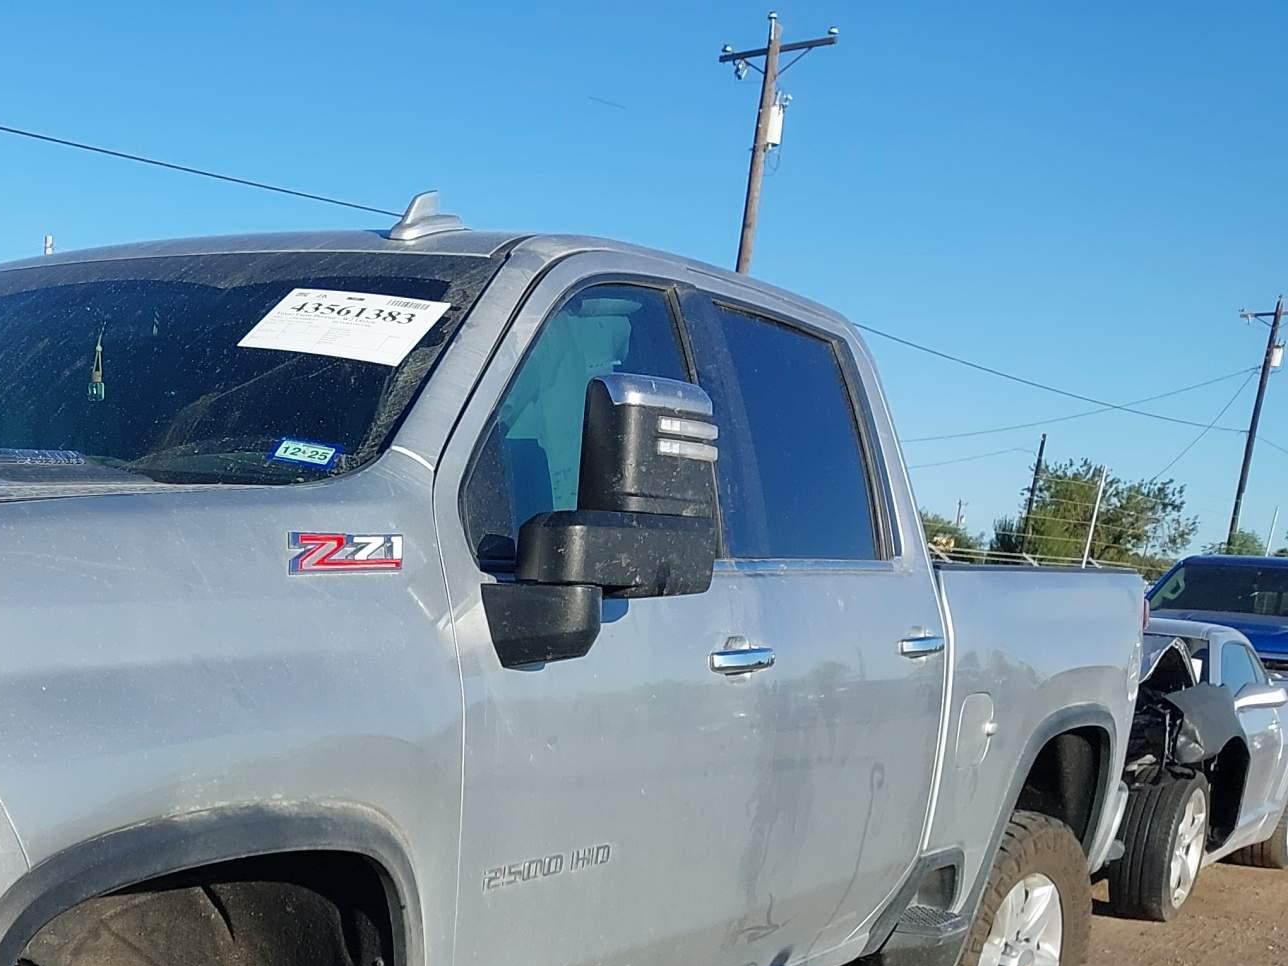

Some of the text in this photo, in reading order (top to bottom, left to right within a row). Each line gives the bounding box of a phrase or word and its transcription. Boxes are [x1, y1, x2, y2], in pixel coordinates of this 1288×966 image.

[290, 301, 417, 326] 43561383
[288, 532, 404, 575] Z71
[481, 842, 613, 893] 2500 HD
